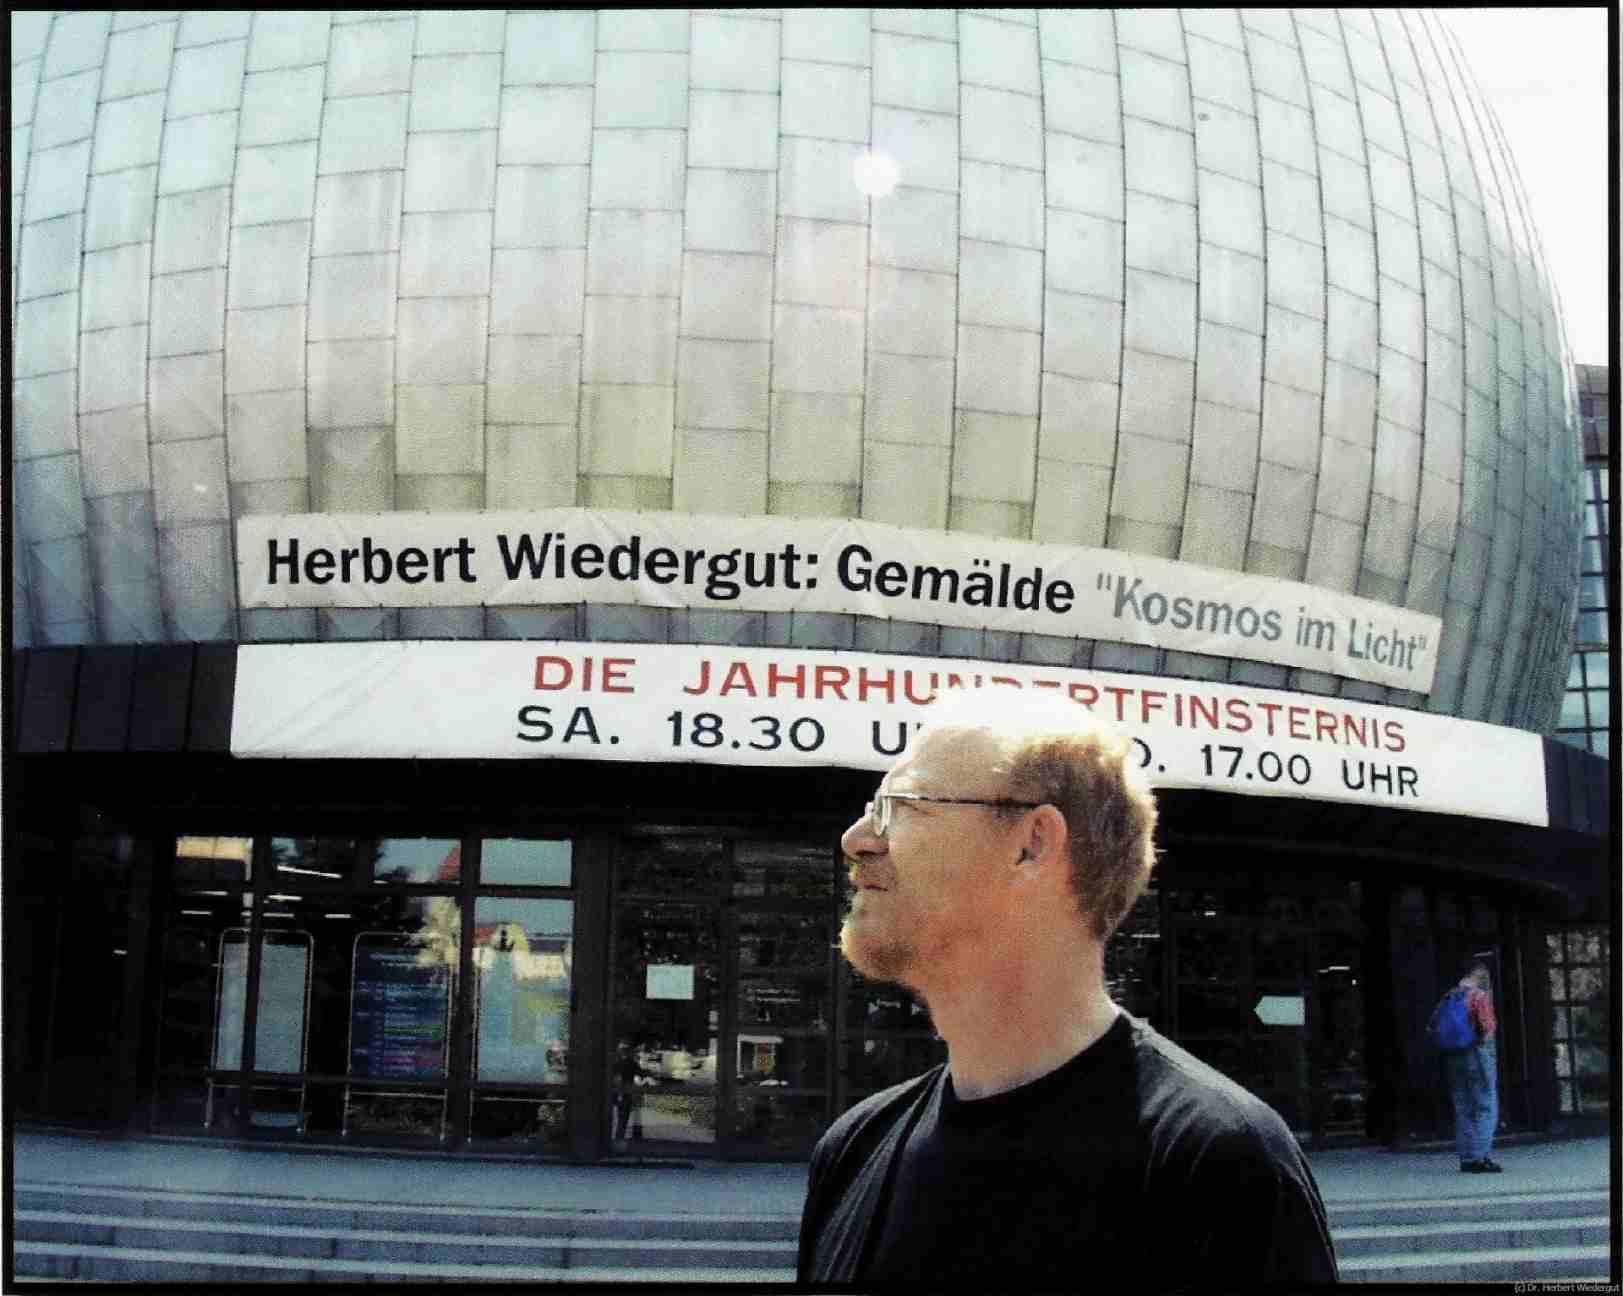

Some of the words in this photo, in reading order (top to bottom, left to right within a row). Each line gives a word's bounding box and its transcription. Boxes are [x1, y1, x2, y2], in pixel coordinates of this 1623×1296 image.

[266, 538, 477, 585] Herbert
[497, 532, 819, 601] Wiedergut:
[837, 544, 1075, 614] Gemälde
[1096, 573, 1283, 641] "Kosmos
[1297, 606, 1336, 653] im
[1347, 617, 1427, 671] Licht"
[533, 655, 637, 694] DIE
[516, 704, 620, 746] SA.
[667, 710, 826, 752] 18.30
[1200, 744, 1312, 785] 17.00
[1341, 759, 1419, 798] UHR
